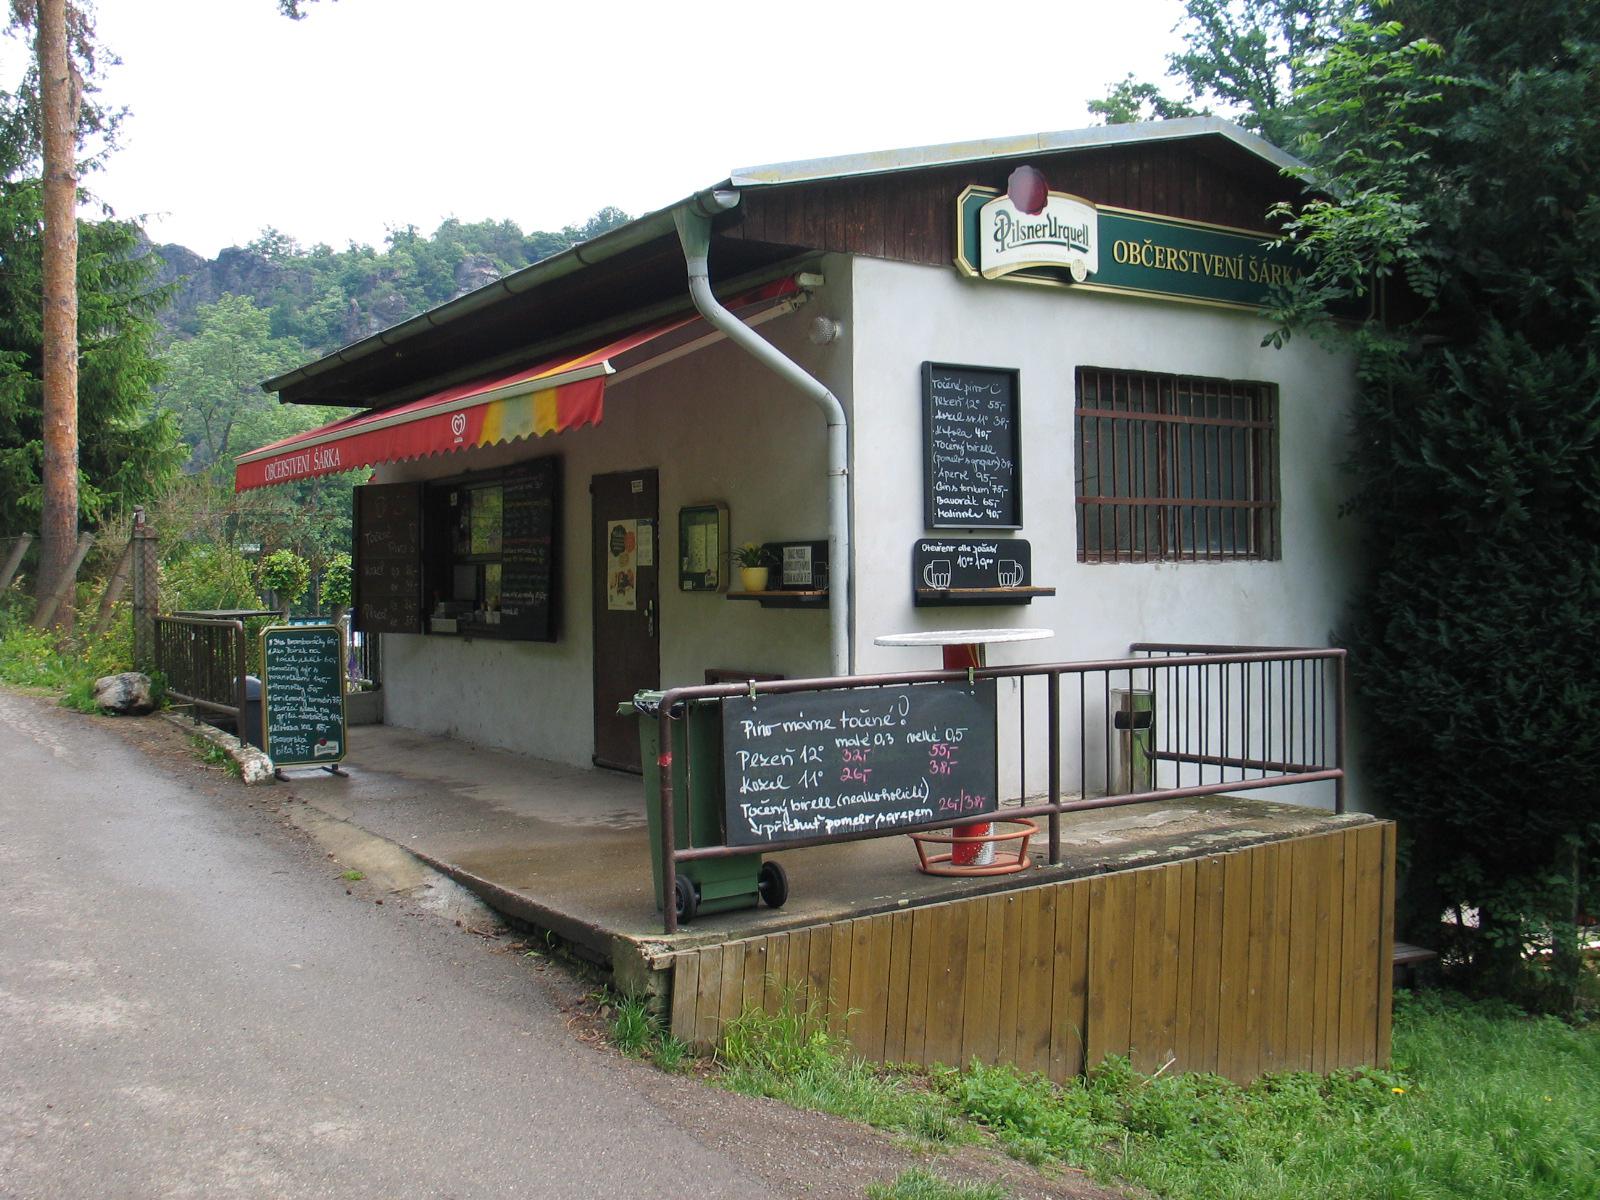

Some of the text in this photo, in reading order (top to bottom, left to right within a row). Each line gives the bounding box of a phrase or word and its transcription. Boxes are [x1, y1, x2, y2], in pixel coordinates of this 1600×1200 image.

[994, 210, 1089, 253] Pilsner Urquell
[1113, 239, 1244, 281] OBČERSTVENÍ
[264, 446, 341, 482] OBČERSTVENÍ ŠÁRKA
[741, 719, 782, 740] Pivo
[783, 711, 837, 733] máme
[835, 726, 969, 748] malé 0,3 velké 0,5
[740, 775, 792, 795] Kozel
[740, 798, 789, 827] Točený
[791, 797, 836, 812] birell
